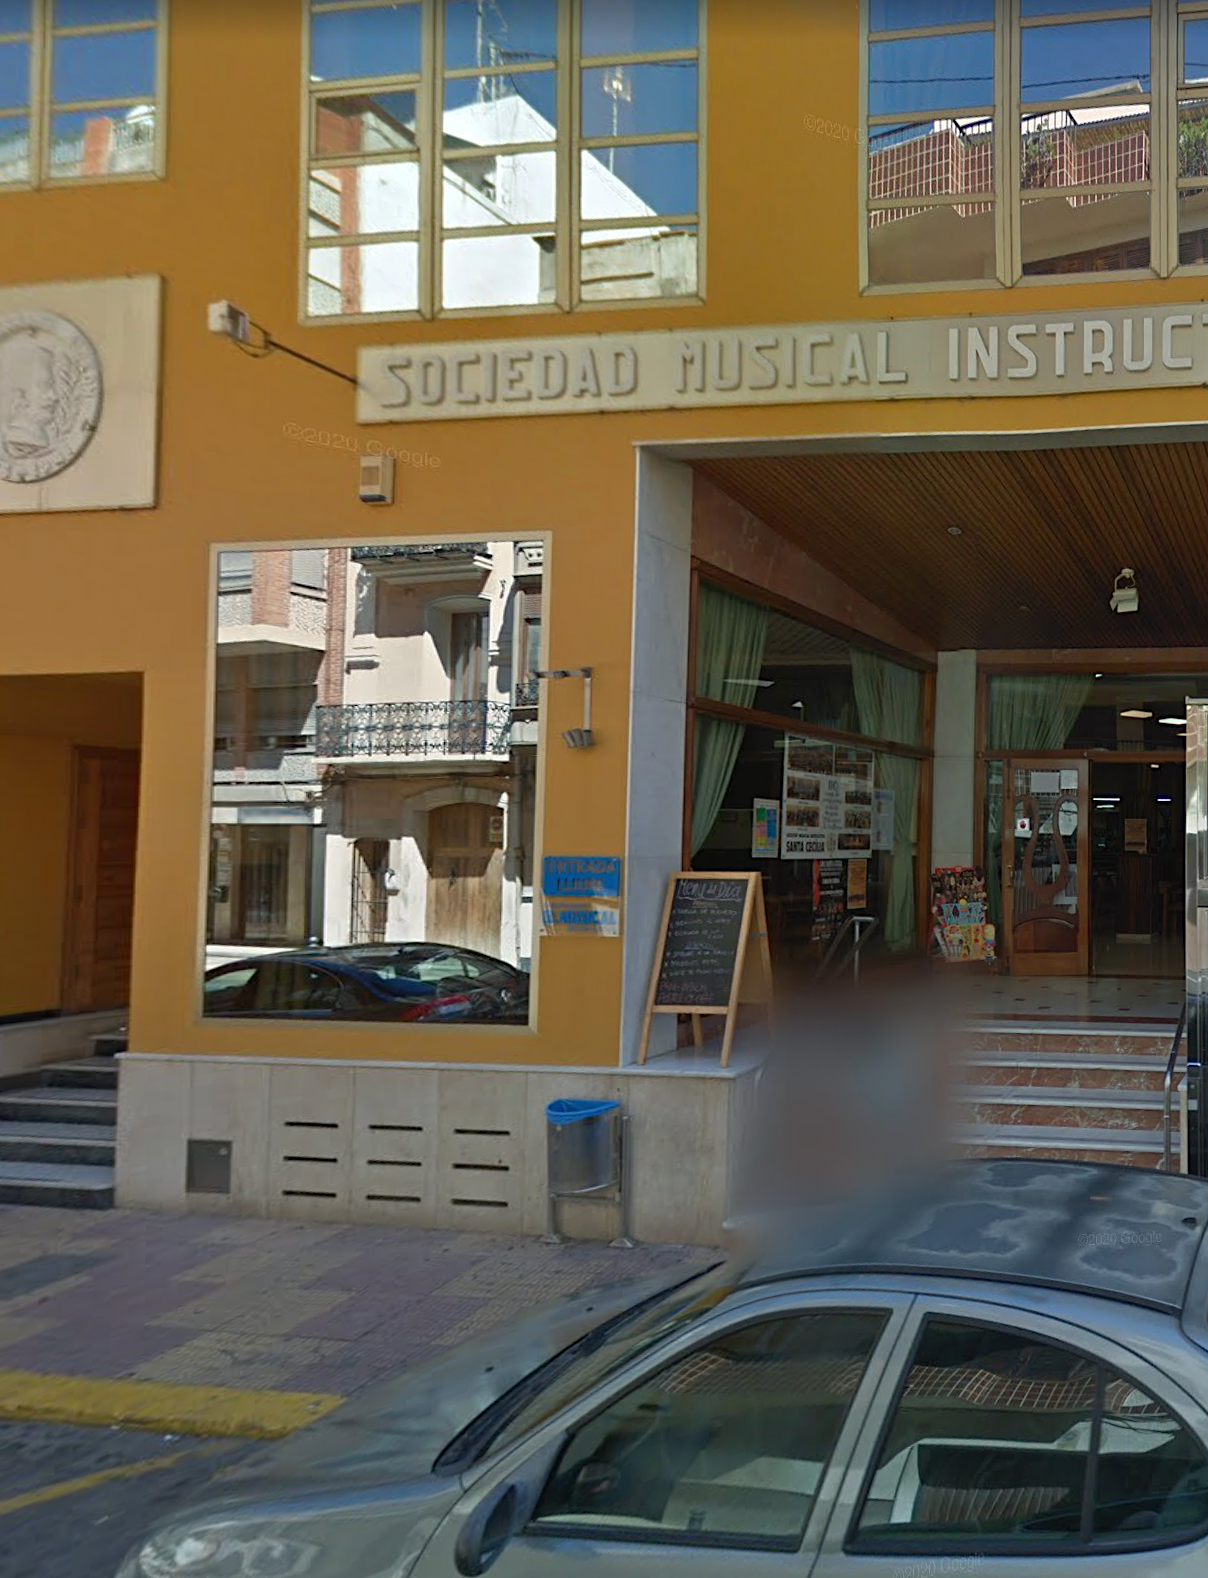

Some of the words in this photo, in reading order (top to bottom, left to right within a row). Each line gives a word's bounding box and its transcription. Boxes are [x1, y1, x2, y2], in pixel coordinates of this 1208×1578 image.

[380, 343, 638, 408] SOCIEDAD
[675, 331, 909, 393] MUSICAL
[786, 841, 804, 852] SANTA
[805, 841, 825, 852] CECILIA
